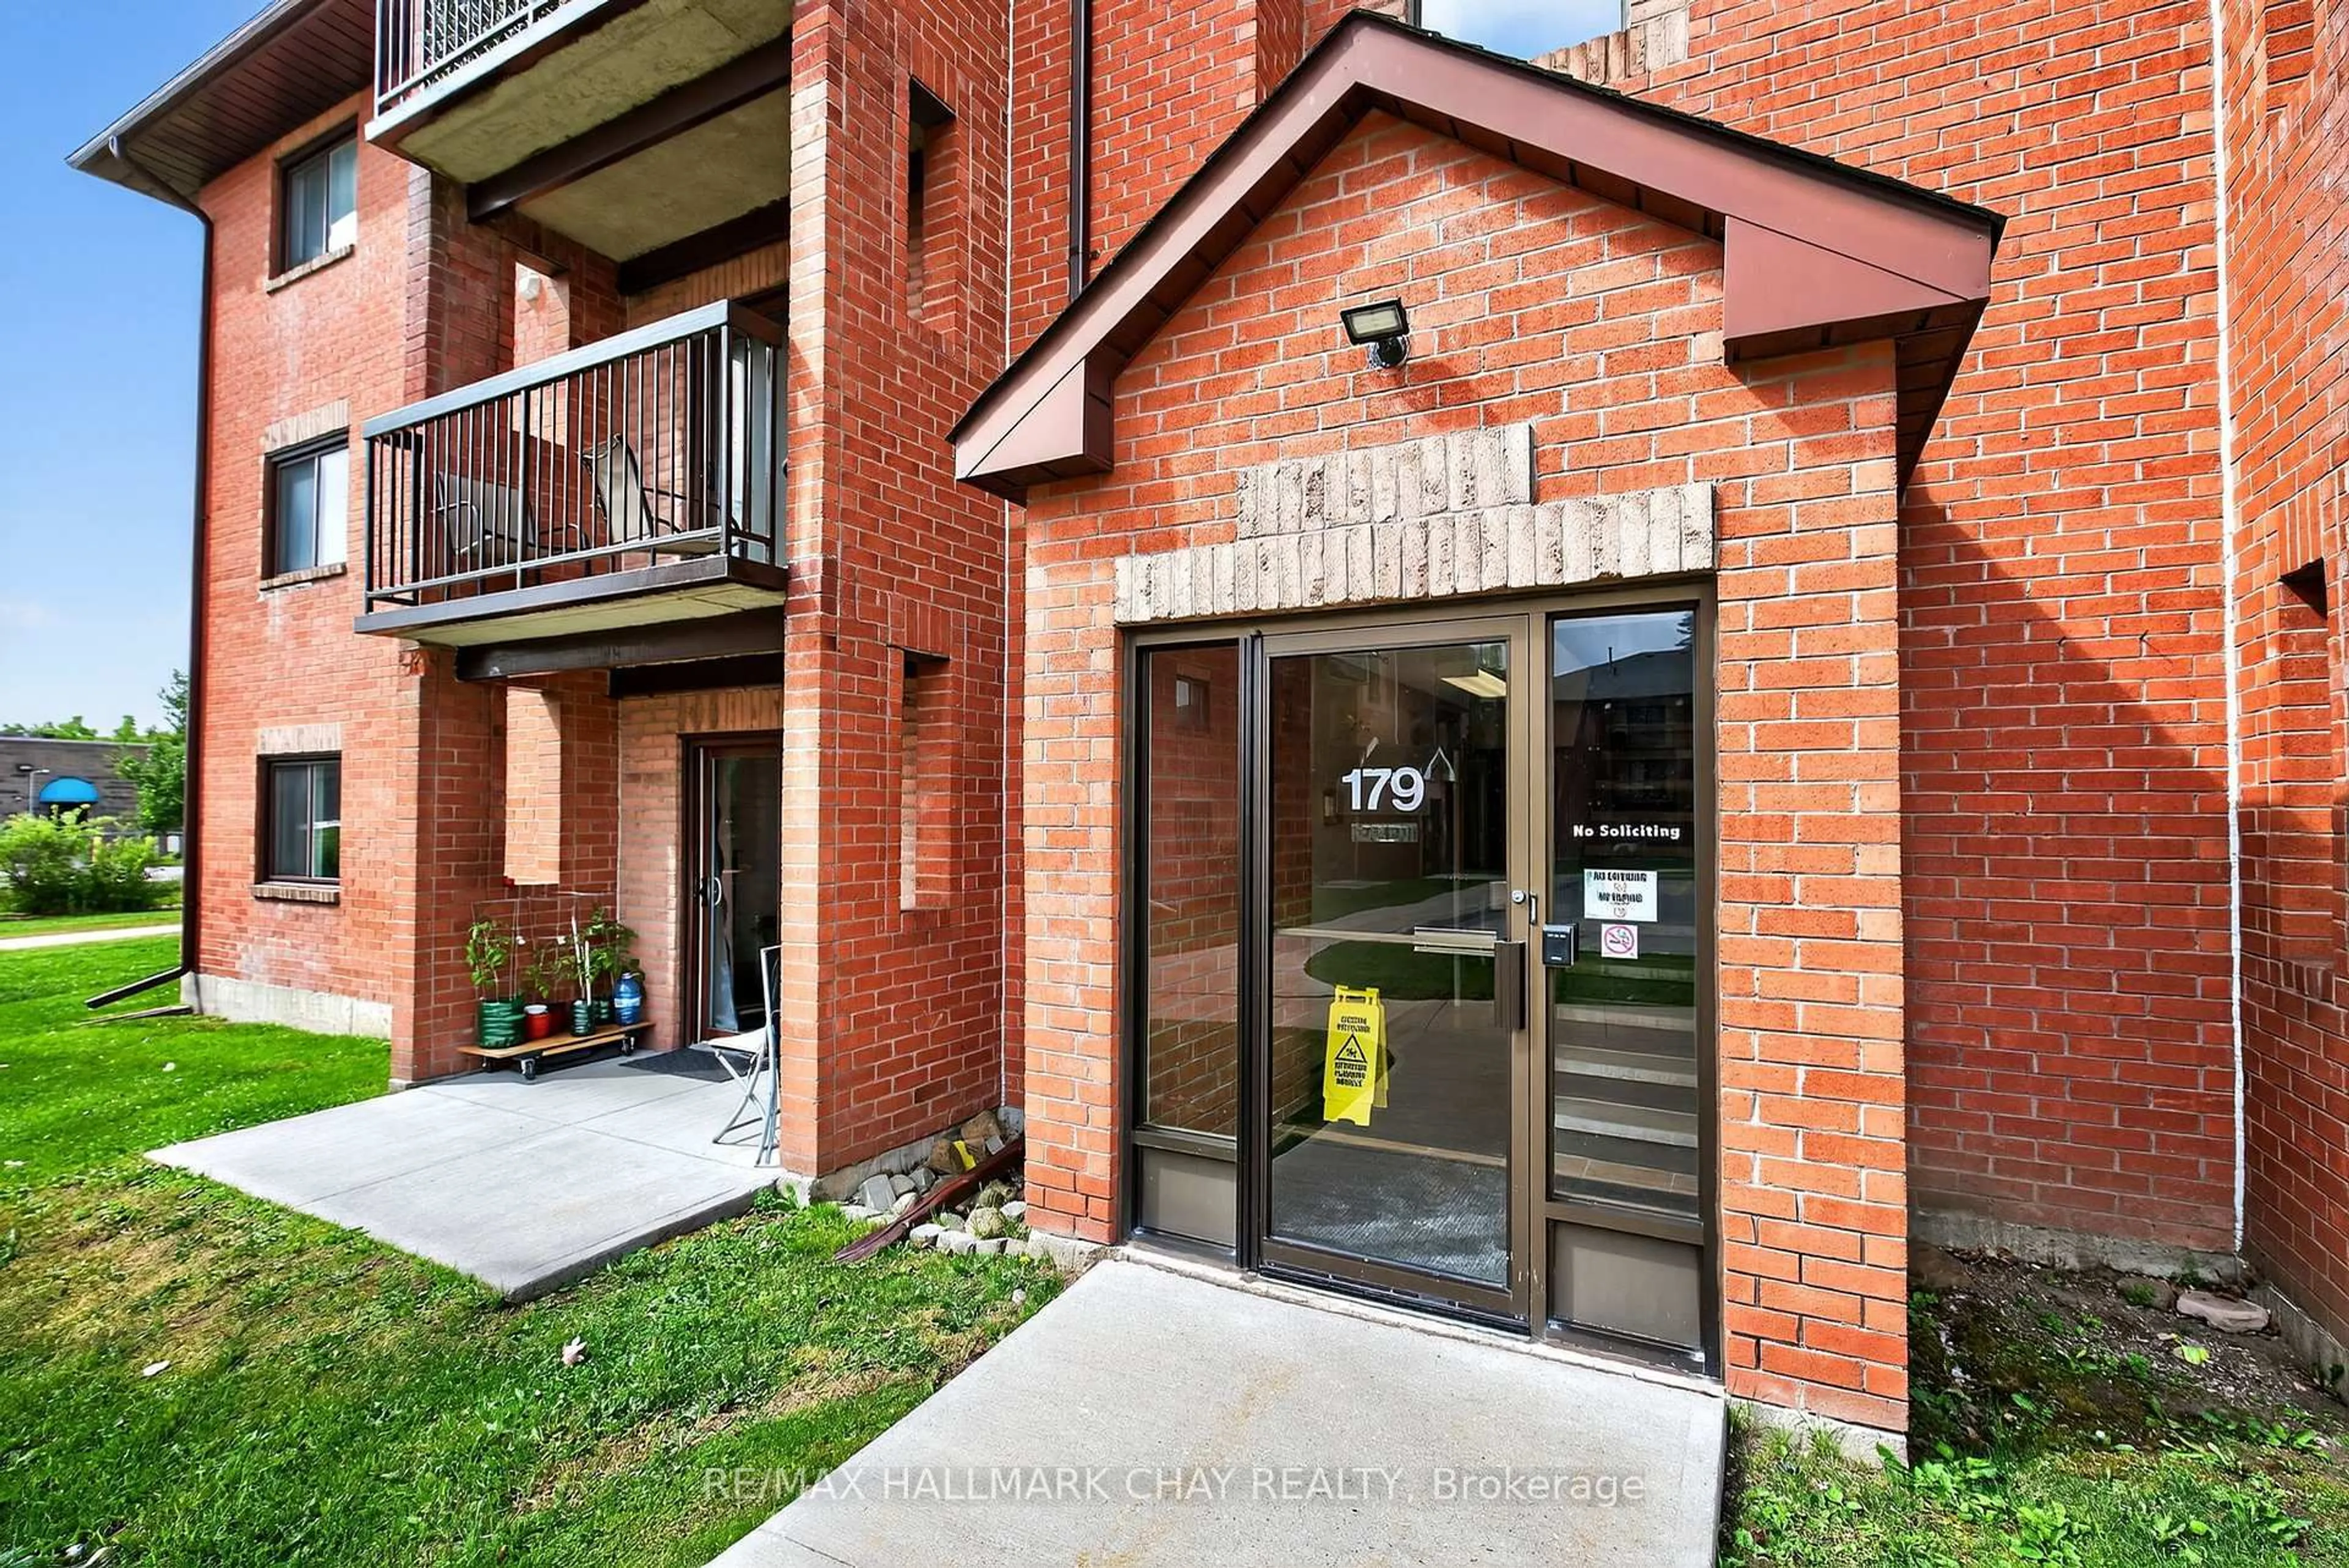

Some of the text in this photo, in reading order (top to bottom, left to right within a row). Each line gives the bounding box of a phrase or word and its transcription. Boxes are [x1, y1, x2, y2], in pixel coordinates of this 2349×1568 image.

[1341, 766, 1425, 812] 179
[1573, 824, 1680, 840] No Soliciting
